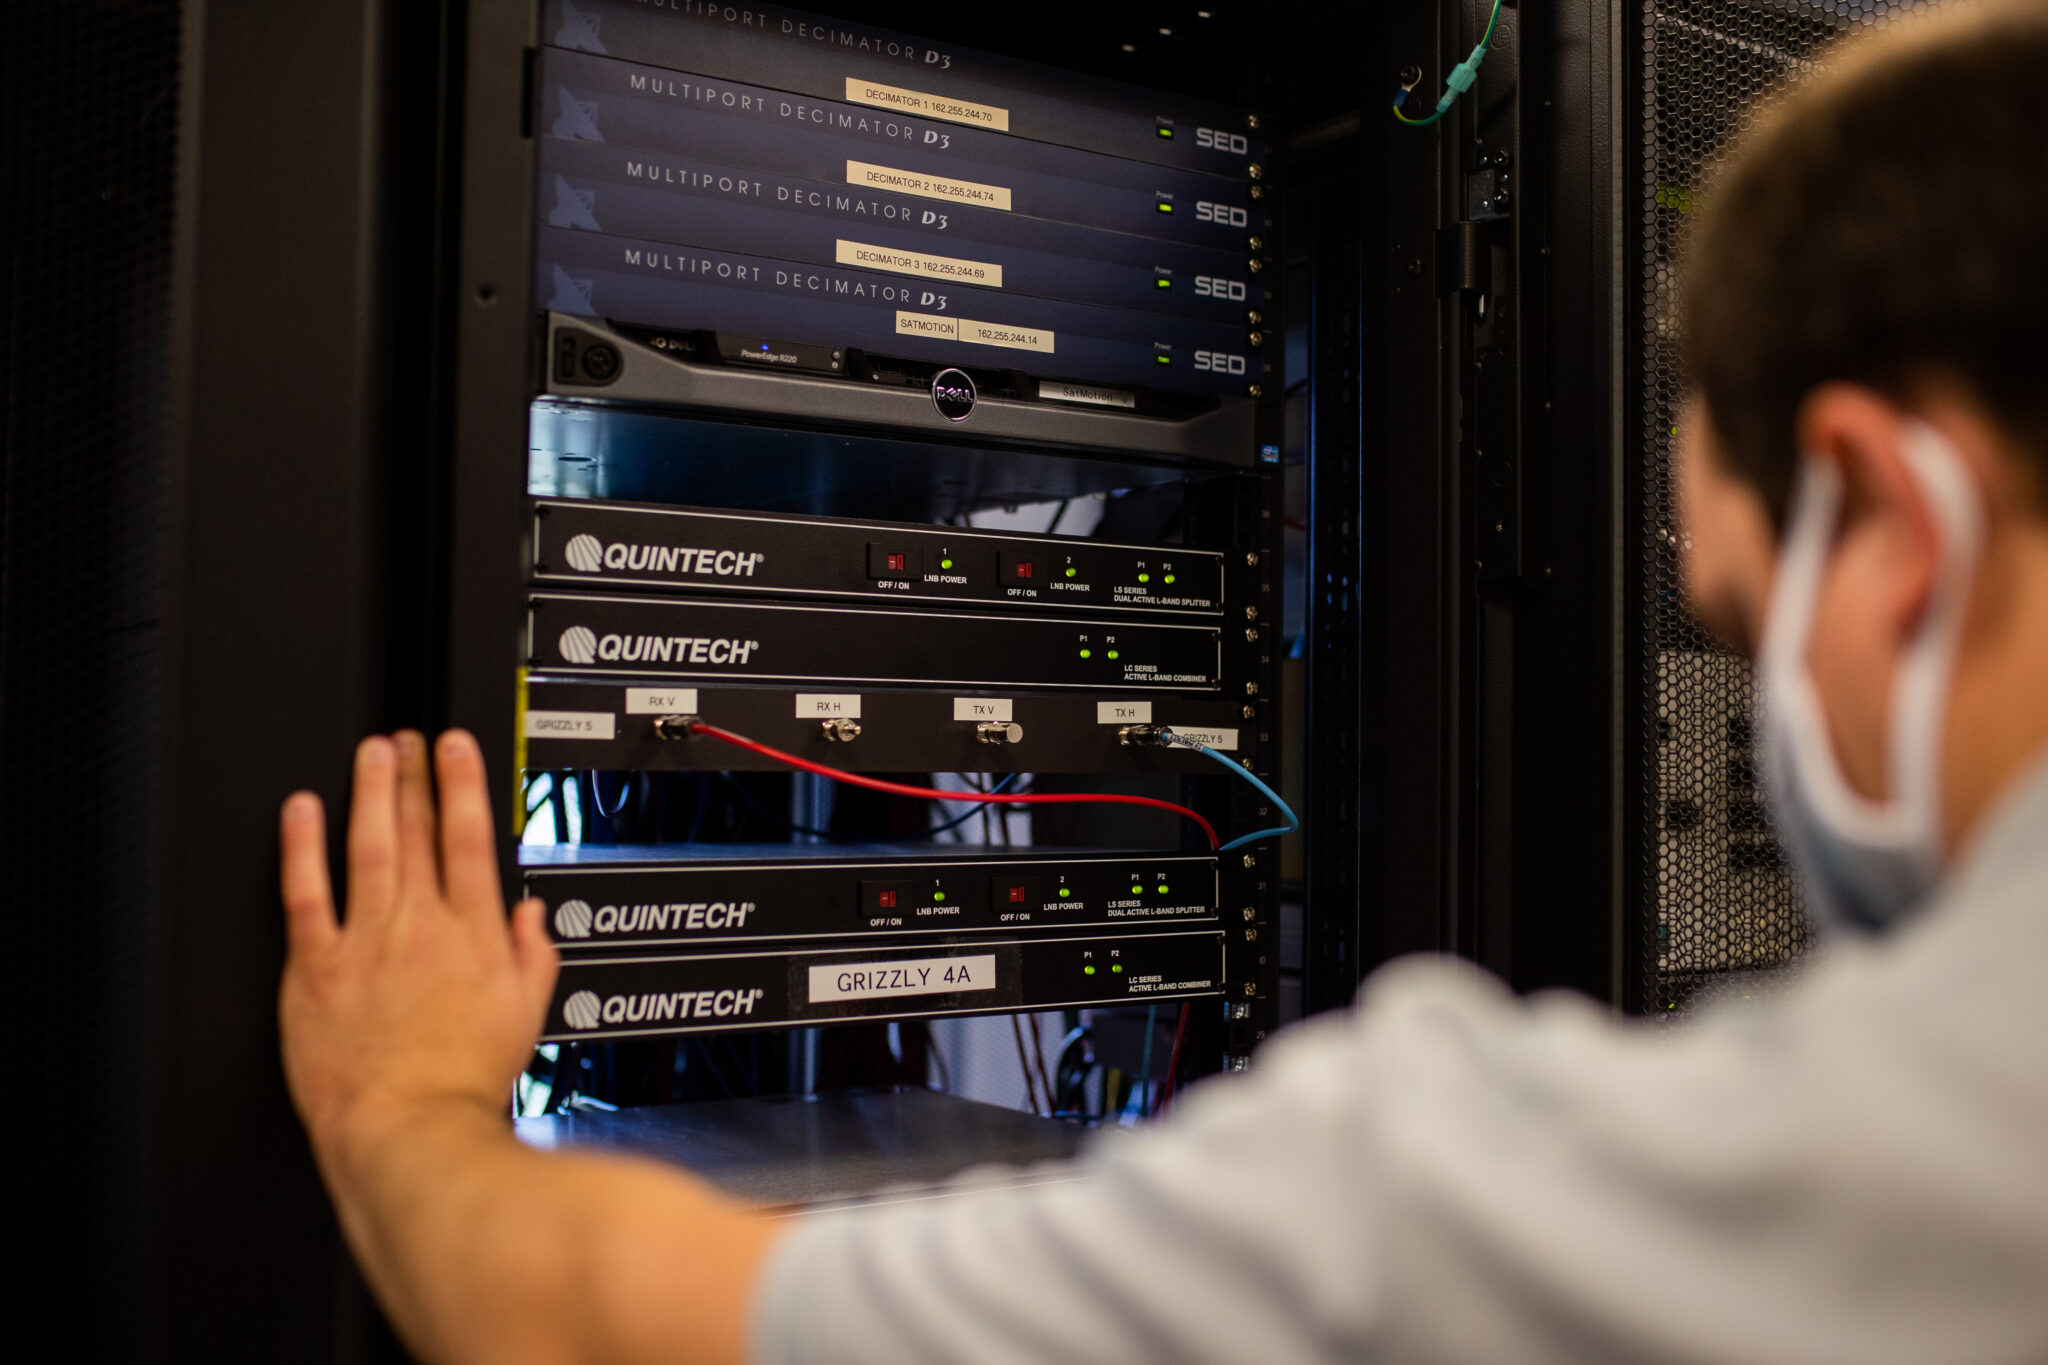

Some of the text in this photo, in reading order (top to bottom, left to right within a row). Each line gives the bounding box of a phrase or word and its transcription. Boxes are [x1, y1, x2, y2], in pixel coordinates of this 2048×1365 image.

[637, 0, 951, 70] LTIPORT DECIMATOR D3
[866, 88, 993, 122] DECIMATOR 1 162.255.244.70
[630, 74, 951, 149] MULTIPORT DECIMATOR D3
[1196, 127, 1248, 155] SED
[866, 171, 994, 202] DECIMATOR 2 162.255.244.74
[627, 161, 949, 230] MULTIPORT DECIMATOR D3
[1156, 190, 1174, 200] Power
[1196, 201, 1247, 228] SED
[856, 250, 985, 279] DECIMATOR 3 162.255.244.69
[1154, 266, 1172, 275] Power
[625, 249, 948, 311] MULTIPORT DECIMATOR D3
[1194, 275, 1246, 302] SED
[900, 318, 954, 334] SATMOTION
[977, 328, 1038, 345] 162.255.244.14
[740, 348, 798, 364] PowerEdge R220
[1194, 350, 1246, 376] SED
[936, 386, 973, 403] DELL
[1063, 386, 1113, 402] SatMotion
[1066, 556, 1071, 564] 2
[1137, 561, 1146, 569] P1
[1163, 563, 1172, 571] P2
[924, 574, 967, 584] LNB POWER
[878, 580, 894, 589] OFF
[898, 581, 910, 590] ON
[1050, 582, 1090, 592] LNB POWER
[1114, 586, 1147, 595] LS SERIES
[1007, 588, 1022, 597] OFF
[1026, 589, 1037, 598] ON
[1114, 595, 1211, 607] DUAL ACTIVE L-BAND SPLITTER
[1079, 634, 1088, 642] P1
[1124, 664, 1157, 673] LC SERIES
[1124, 673, 1206, 683] ACTIVE L-BAND COMBINER
[649, 695, 676, 707] RX V
[816, 701, 841, 712] RX H
[972, 704, 995, 715] TX V
[1115, 708, 1135, 718] TX H
[535, 719, 593, 731] GRIZZLY 5
[1217, 734, 1223, 744] 5
[1131, 873, 1139, 881] P1
[1043, 902, 1083, 911] LNB POWER
[1117, 900, 1141, 908] SERIES
[917, 906, 960, 916] LNB POWER
[1108, 906, 1205, 917] DUAL ACTIVE L-BAND SPLITTER
[870, 918, 886, 927] OFF
[890, 918, 902, 926] ON
[1000, 913, 1015, 922] OFF
[1019, 913, 1030, 921] ON
[837, 965, 971, 993] GRIZZLY 4A
[1129, 975, 1162, 984] LC SERIES
[1129, 980, 1211, 993] ACTIVE L-BAND COMBINER
